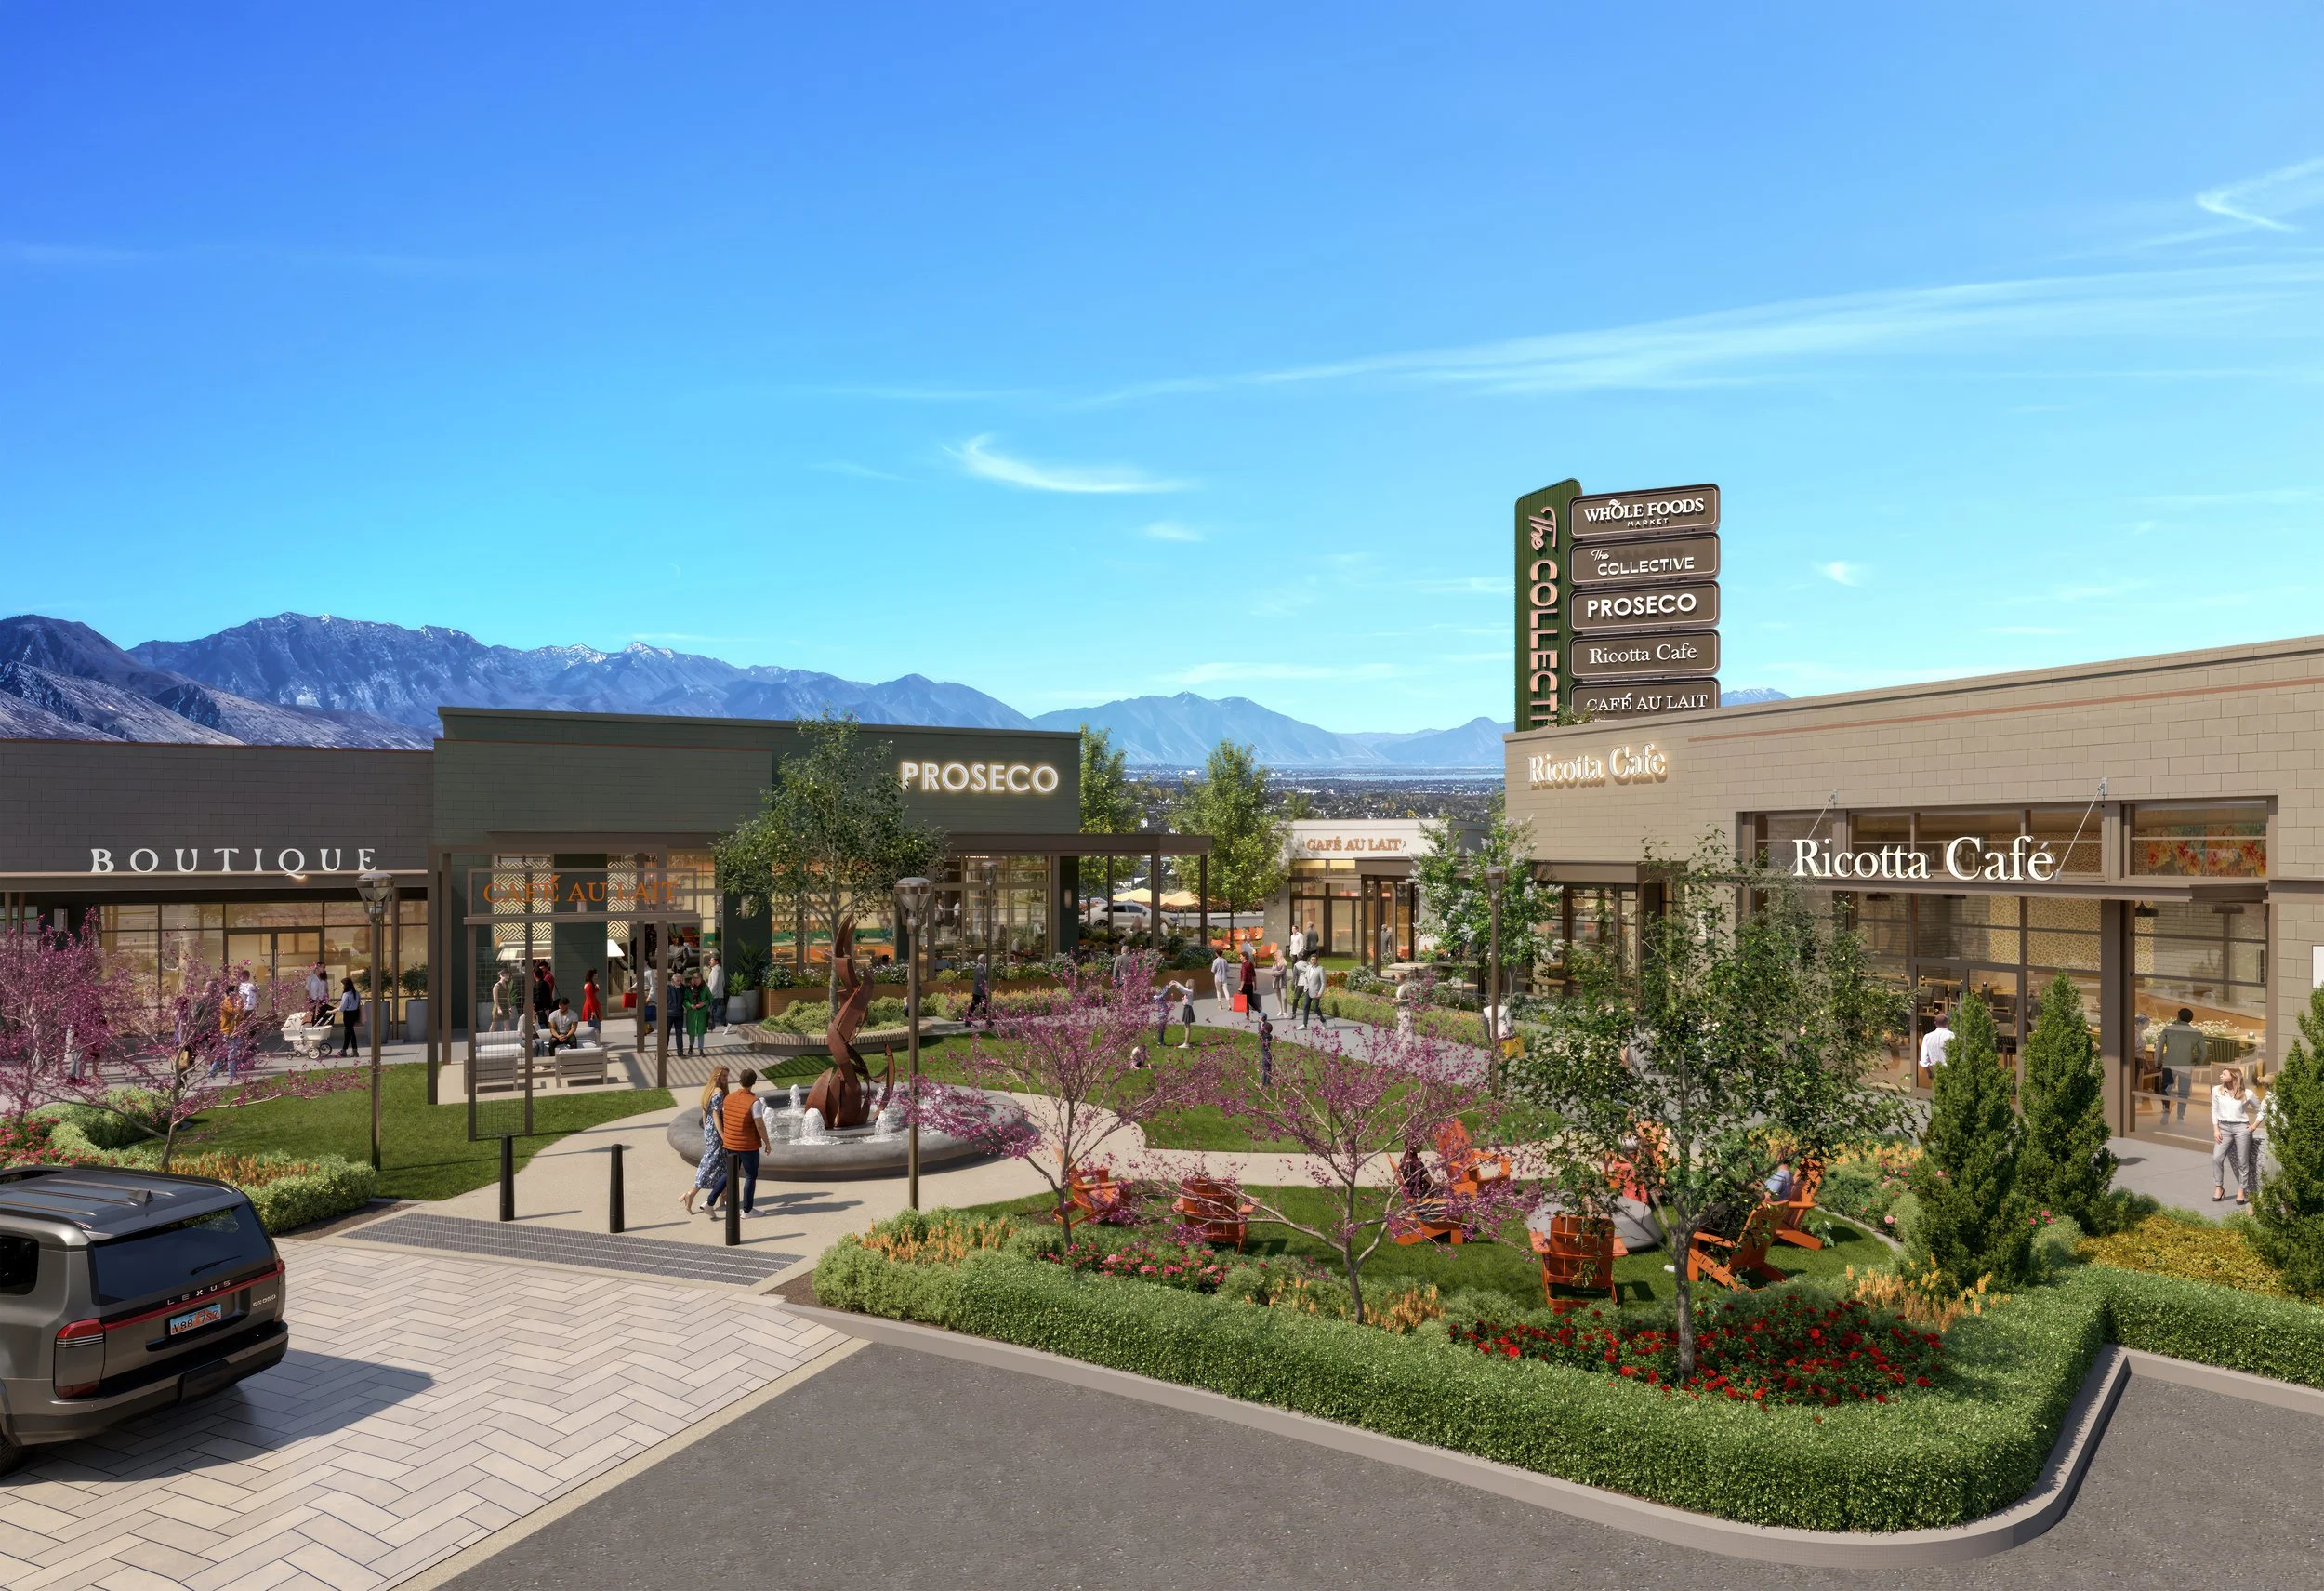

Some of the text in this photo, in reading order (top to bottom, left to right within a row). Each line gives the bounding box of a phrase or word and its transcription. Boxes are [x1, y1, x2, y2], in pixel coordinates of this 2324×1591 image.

[1583, 497, 1705, 522] WHOLE FOODS
[1627, 517, 1669, 527] MARKET
[1528, 506, 1557, 550] The
[1591, 549, 1610, 562] The
[1597, 556, 1695, 577] COLLECTIVE
[1587, 593, 1697, 618] PROSECO
[1589, 643, 1697, 664] Ricotta Cafe
[1586, 692, 1709, 712] CAFÉ AU LAIT
[901, 762, 1059, 792] PROSECO
[1527, 753, 1604, 784] Ricotta
[1306, 835, 1402, 852] CAFÉ AU LAIT
[90, 847, 376, 880] BOUTIQUE
[1792, 835, 2054, 882] Ricotta Café
[482, 874, 679, 904] CAFÉ AU LAIT
[167, 1279, 231, 1306] LEXUS
